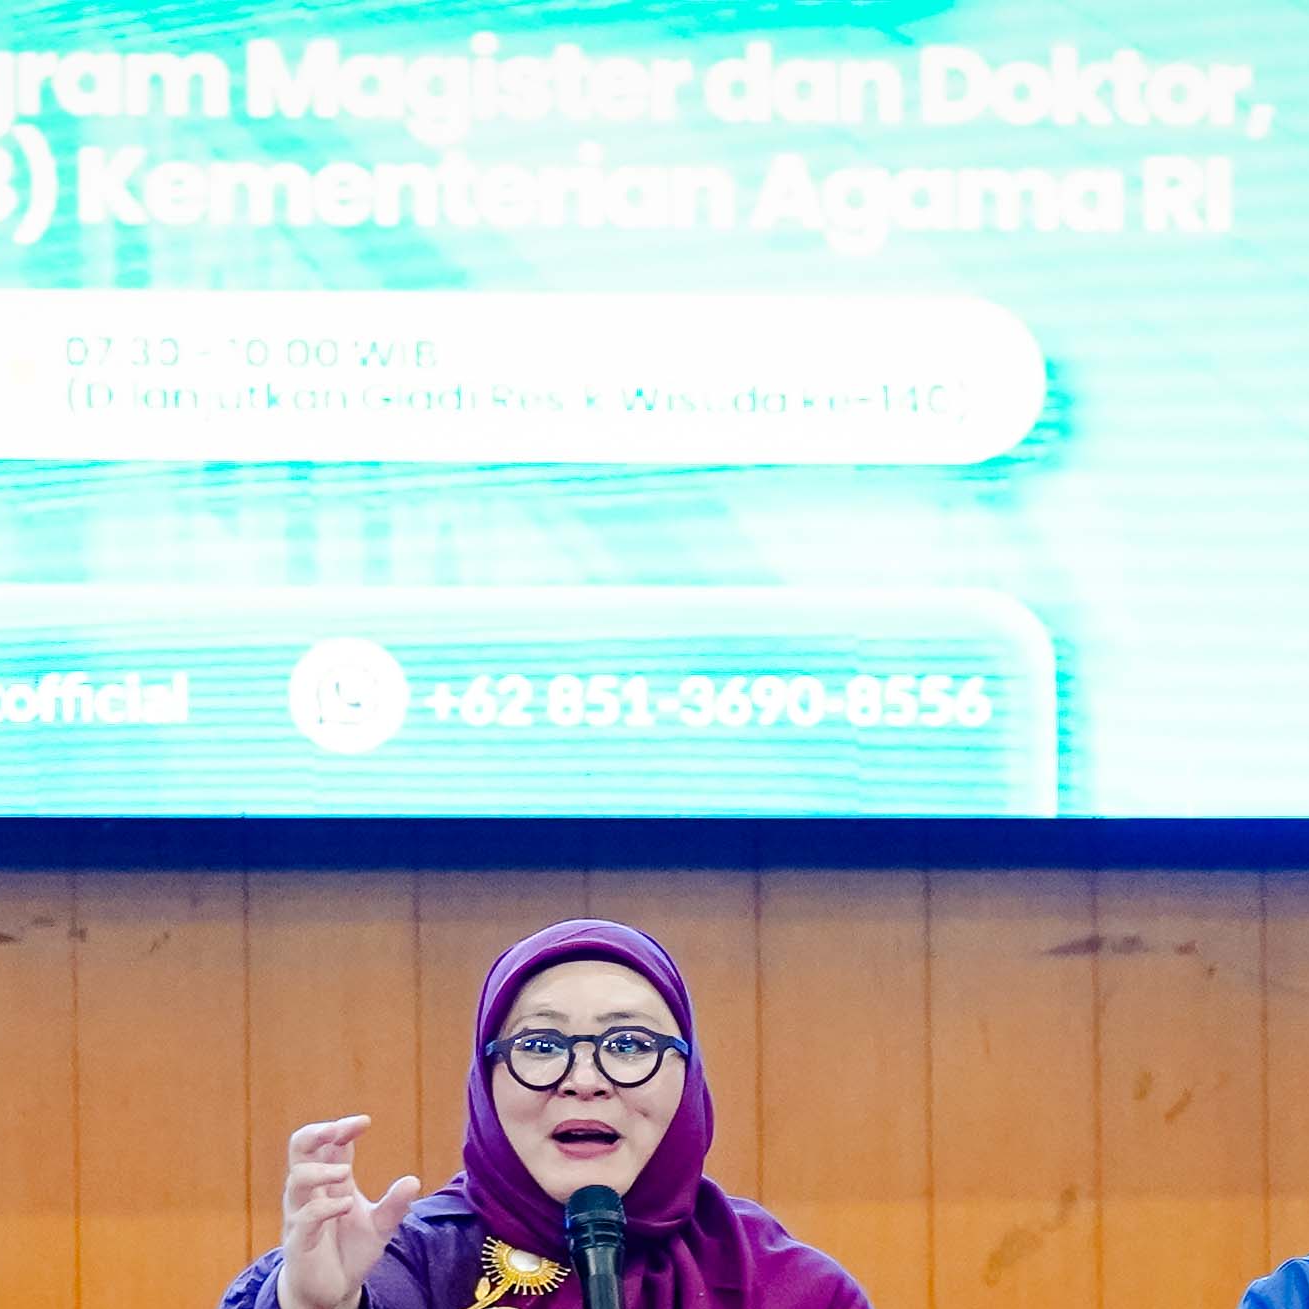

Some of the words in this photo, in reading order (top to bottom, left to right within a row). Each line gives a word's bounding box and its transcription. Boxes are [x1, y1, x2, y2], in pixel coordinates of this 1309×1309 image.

[246, 31, 693, 147] Magister
[702, 41, 903, 124] dan
[919, 45, 1275, 139] Doktor,
[77, 141, 735, 232] Kementerian
[747, 153, 1123, 255] Agama
[1142, 156, 1234, 232] RI
[66, 336, 181, 368] 0730
[426, 674, 534, 727] +62
[547, 674, 993, 727] 851-3690-8556
